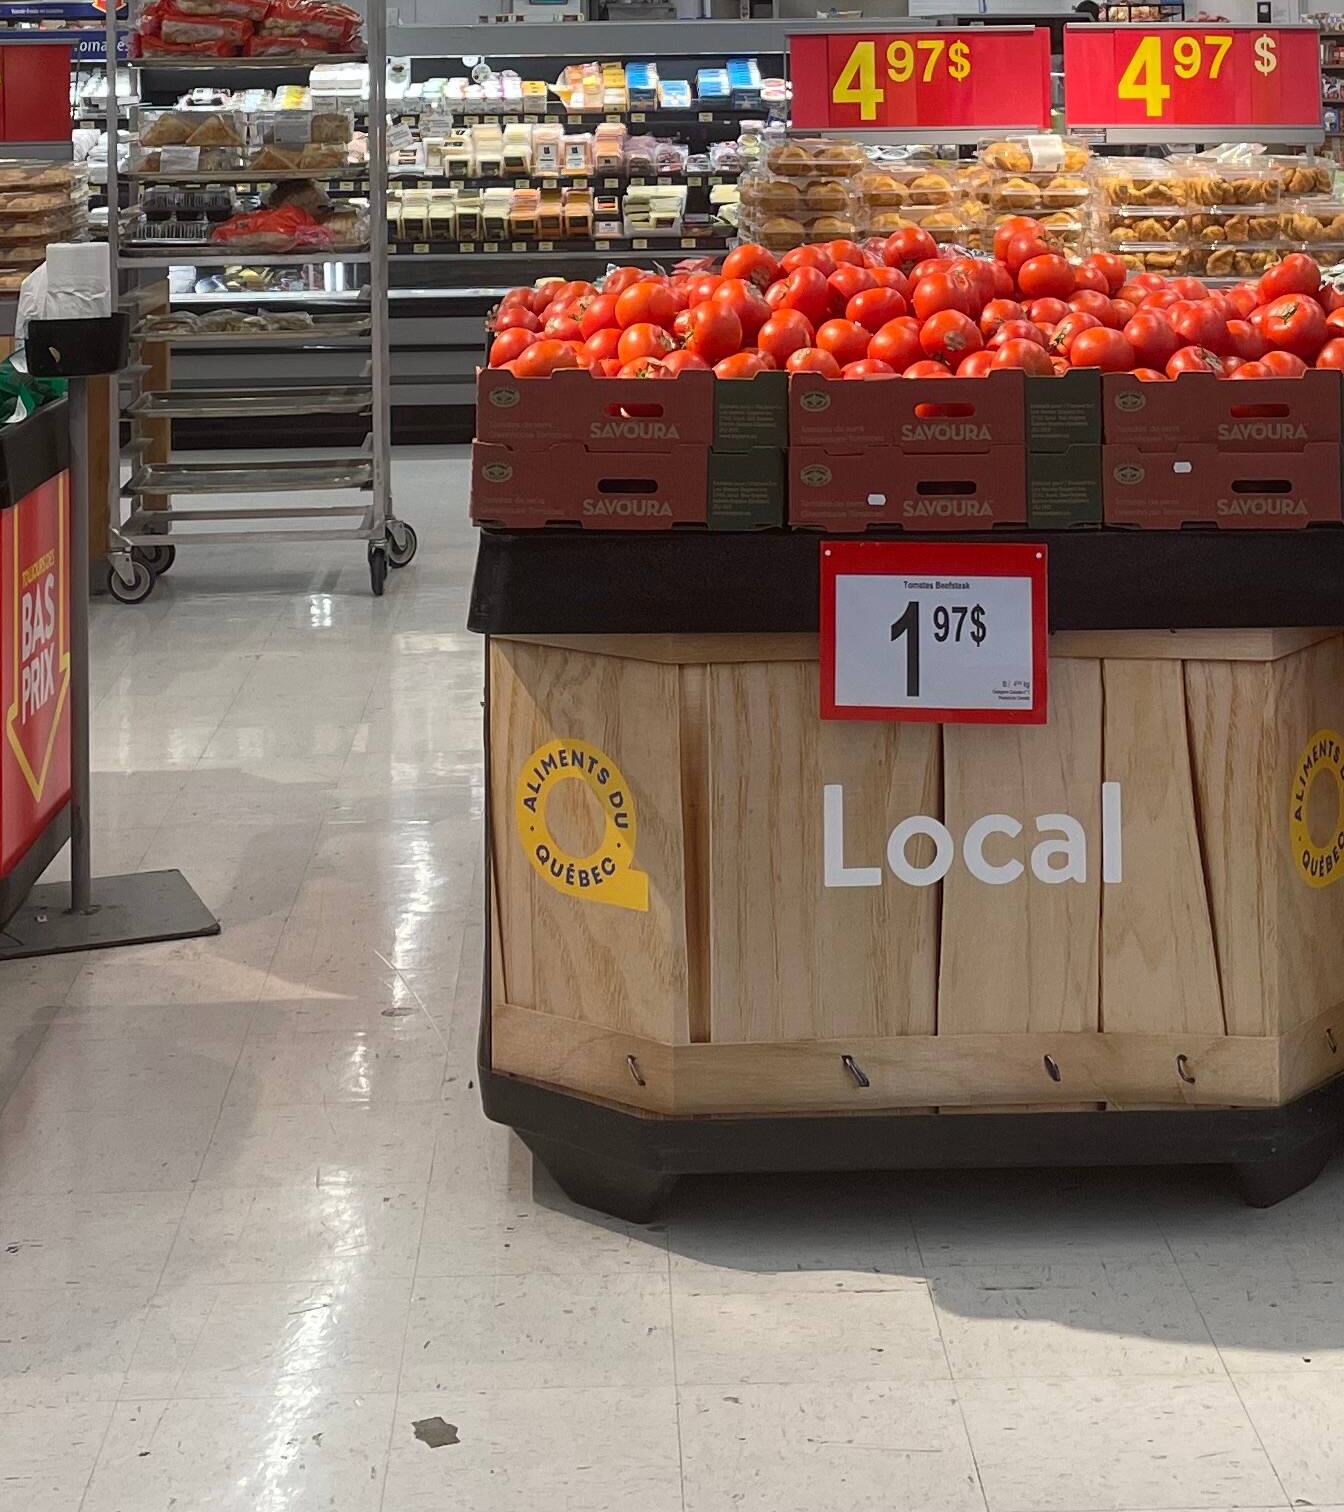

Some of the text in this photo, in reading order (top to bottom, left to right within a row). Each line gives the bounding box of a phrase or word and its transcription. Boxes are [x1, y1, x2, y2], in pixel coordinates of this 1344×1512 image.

[590, 421, 680, 439] SAVOURA
[901, 423, 991, 441] SAVOURA
[1218, 422, 1307, 440] SAVOURA
[583, 498, 672, 516] SAVOURA
[903, 499, 993, 517] SAVOURA
[1217, 498, 1307, 516] SAVOURA
[903, 581, 970, 590] Tomates Beefsteak
[22, 572, 55, 662] BAS
[22, 643, 55, 725] PRIX
[523, 749, 629, 829] ALIMENTS DU
[1294, 739, 1341, 822] ALIMENTS
[822, 780, 1123, 889] Local
[535, 844, 616, 888] QUÉBEC
